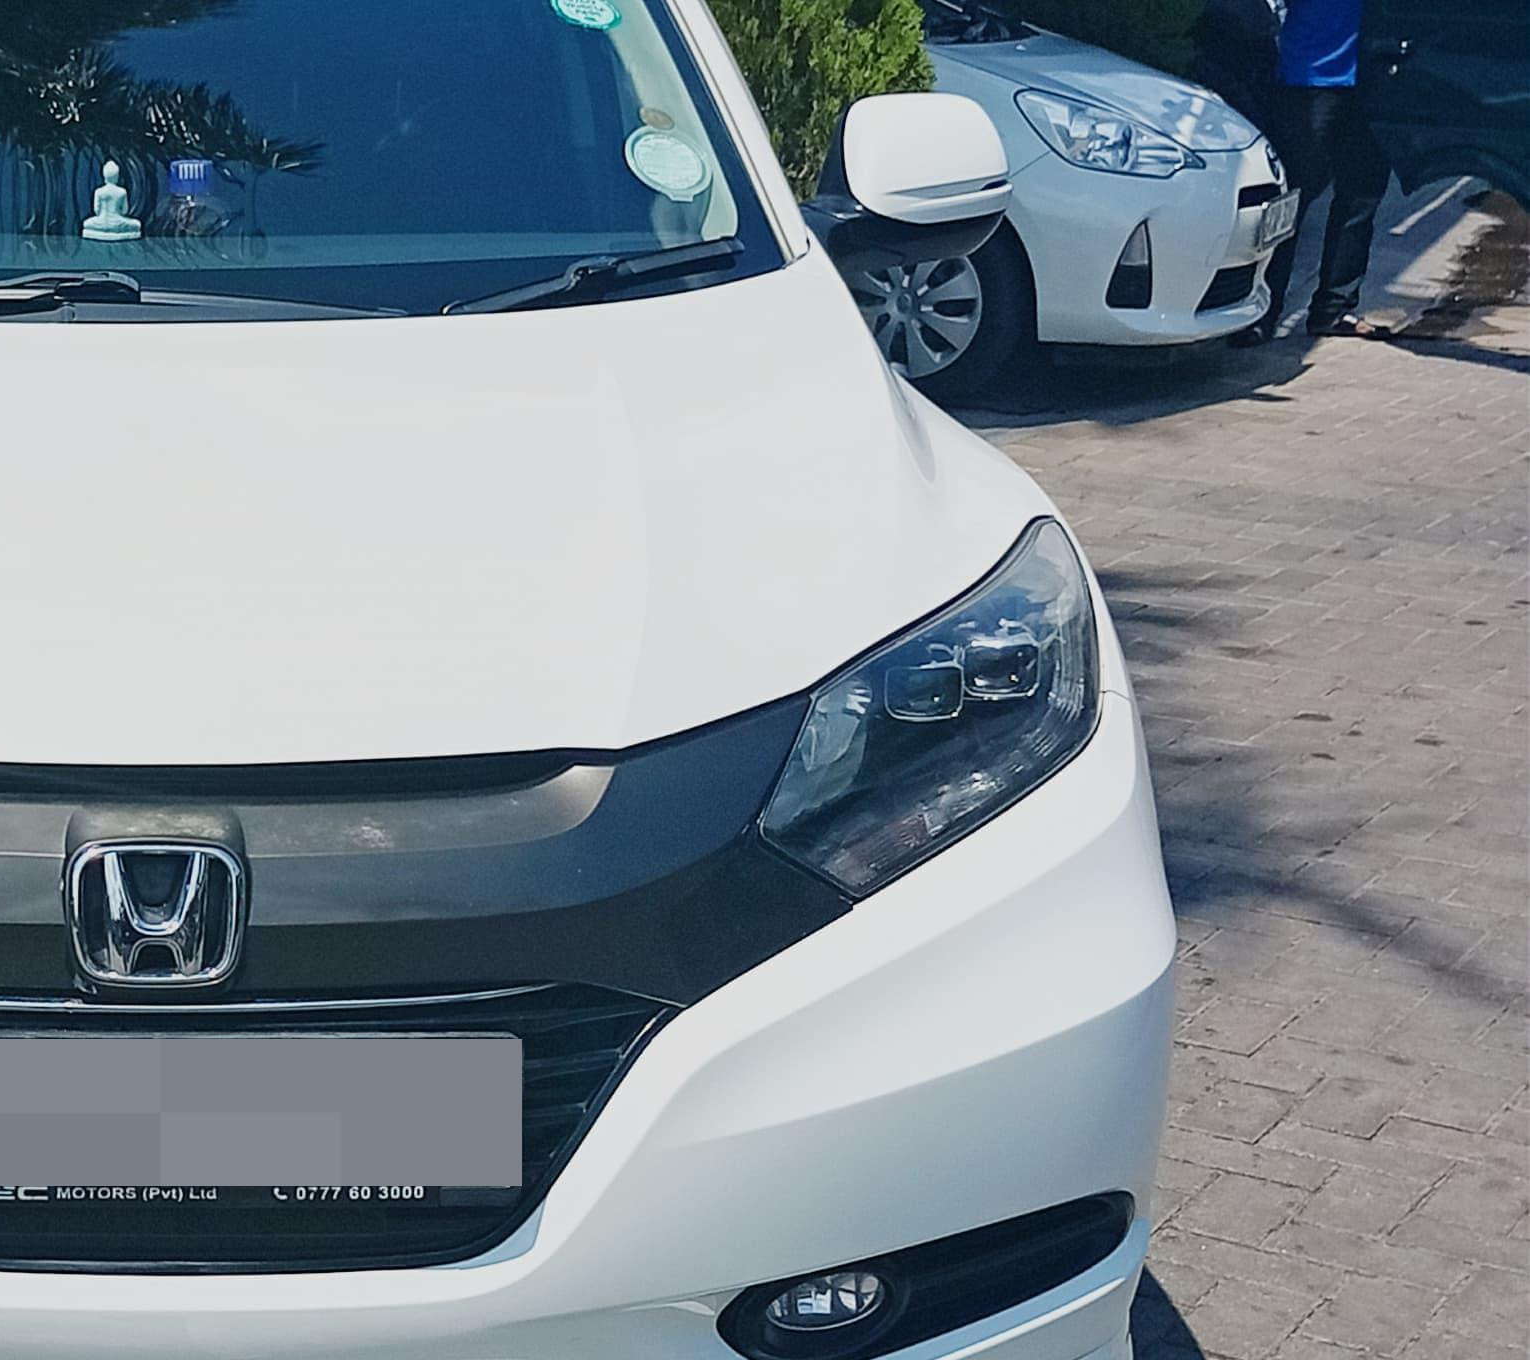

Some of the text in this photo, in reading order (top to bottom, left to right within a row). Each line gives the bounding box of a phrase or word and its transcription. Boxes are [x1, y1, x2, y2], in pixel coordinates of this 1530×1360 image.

[56, 1186, 137, 1201] MOTORS
[142, 1186, 184, 1203] (Pvt)
[189, 1187, 218, 1201] Ltd
[296, 1186, 342, 1201] 0777
[348, 1186, 371, 1200] 60
[378, 1186, 425, 1200] 3000
